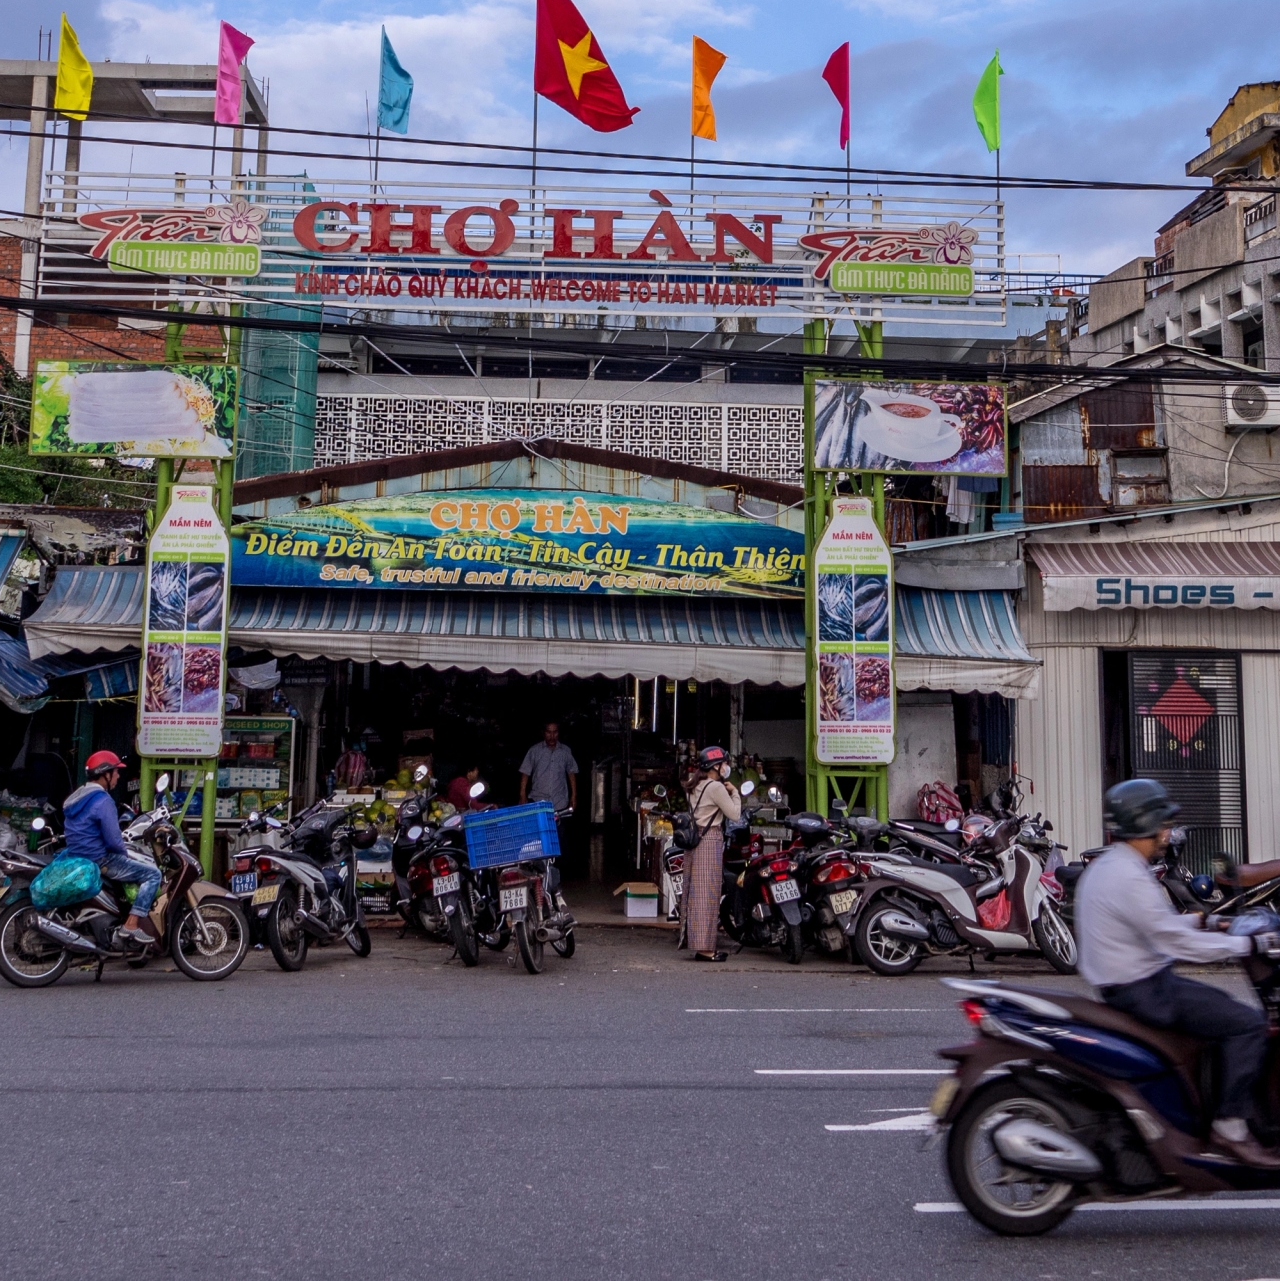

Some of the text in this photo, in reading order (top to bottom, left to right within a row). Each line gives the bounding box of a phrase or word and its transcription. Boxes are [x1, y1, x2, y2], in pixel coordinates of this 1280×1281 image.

[293, 189, 783, 273] CHỢ HÀN
[116, 243, 256, 272] ẨM THỰC ĐÀ NẴNG
[294, 265, 778, 307] KÍNH CHÀO QUÝ KHÁCH WELCOME TO HAN MARKET
[838, 263, 970, 293] ẨM THỰC ĐÀ NẴNG
[169, 516, 212, 528] MẮM NÊM
[430, 496, 631, 540] CHỢ HÀN
[832, 529, 873, 541] MẮM NÊM
[244, 528, 806, 576] Điểm Đến An Toàn Tin Cậy Thân Thiện
[320, 564, 722, 592] Safe, trustful and friendly destination
[1095, 578, 1235, 606] Shoes
[263, 720, 289, 730] SHOP)
[235, 883, 256, 892] 0194
[503, 889, 525, 900] 43-K4
[775, 890, 799, 903] 661.66
[776, 881, 794, 892] 43-C1
